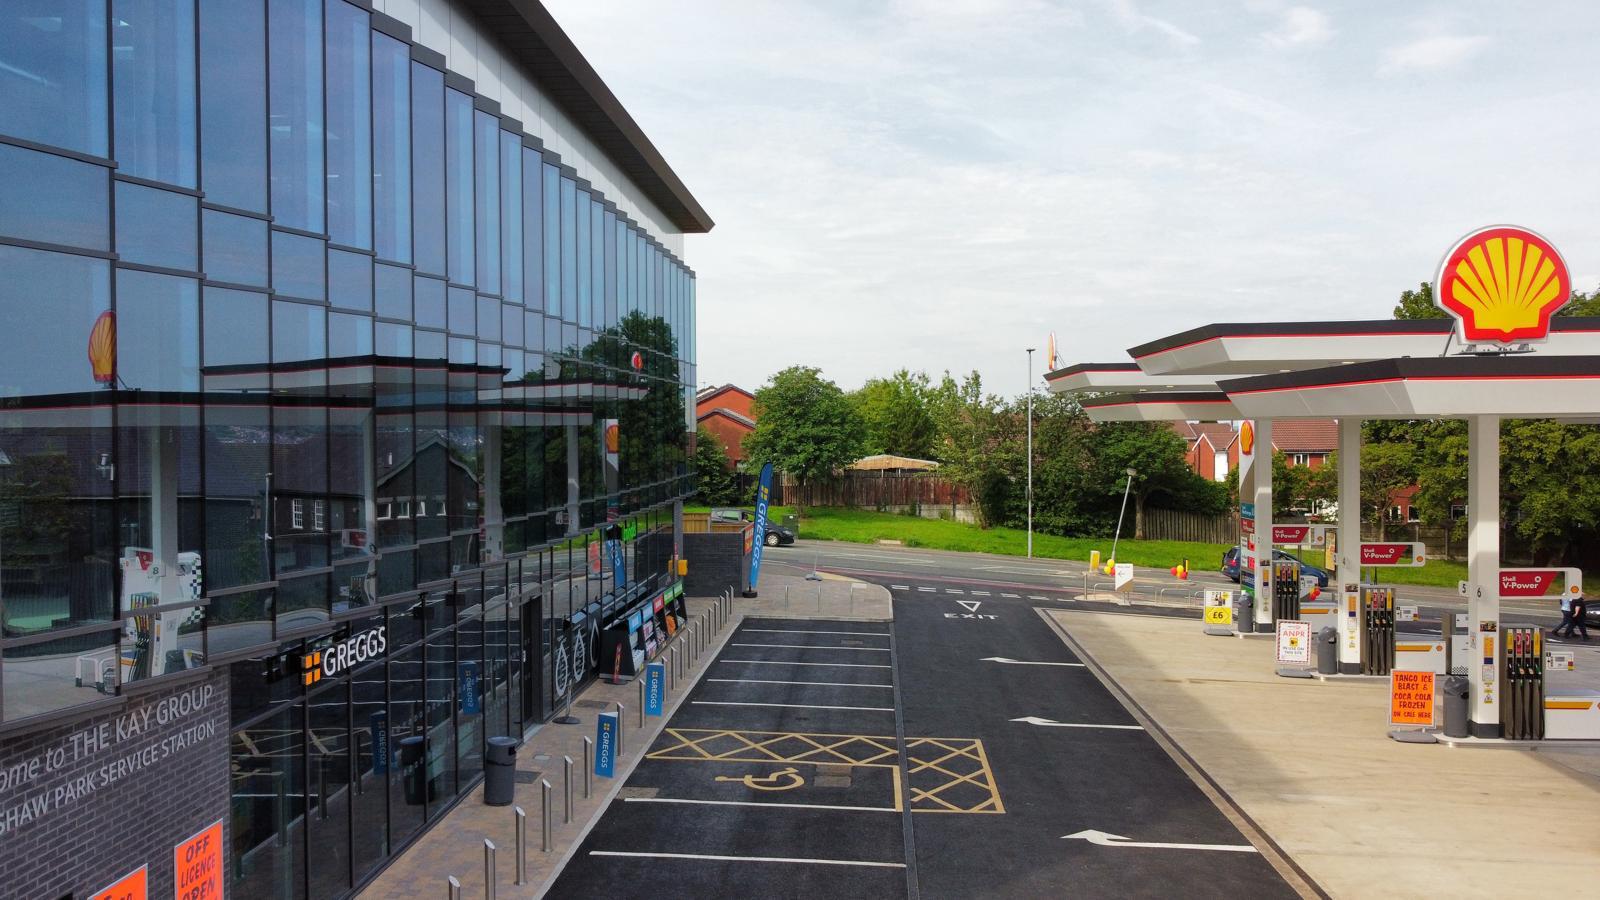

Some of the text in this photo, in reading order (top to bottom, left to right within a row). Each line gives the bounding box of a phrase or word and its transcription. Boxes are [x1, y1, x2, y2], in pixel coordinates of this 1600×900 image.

[752, 502, 767, 569] GREGGS
[943, 612, 999, 620] EXIT
[1213, 611, 1224, 619] £6
[323, 625, 386, 677] GREGGS
[649, 678, 658, 709] GREGGS
[1395, 674, 1433, 683] TANGO ICE
[1398, 682, 1419, 690] BLAST
[1394, 692, 1432, 701] COCA COLA
[1399, 701, 1426, 709] FROZEN
[45, 747, 65, 772] to
[69, 723, 110, 760] THE
[114, 706, 151, 742] KAY
[156, 684, 213, 725] GROUP
[54, 774, 96, 809] PARK
[99, 743, 159, 787] SERVICE
[161, 719, 216, 759] STATION
[600, 731, 610, 769] GREGGS
[186, 835, 210, 864] OFF
[181, 853, 216, 889] LICENCE
